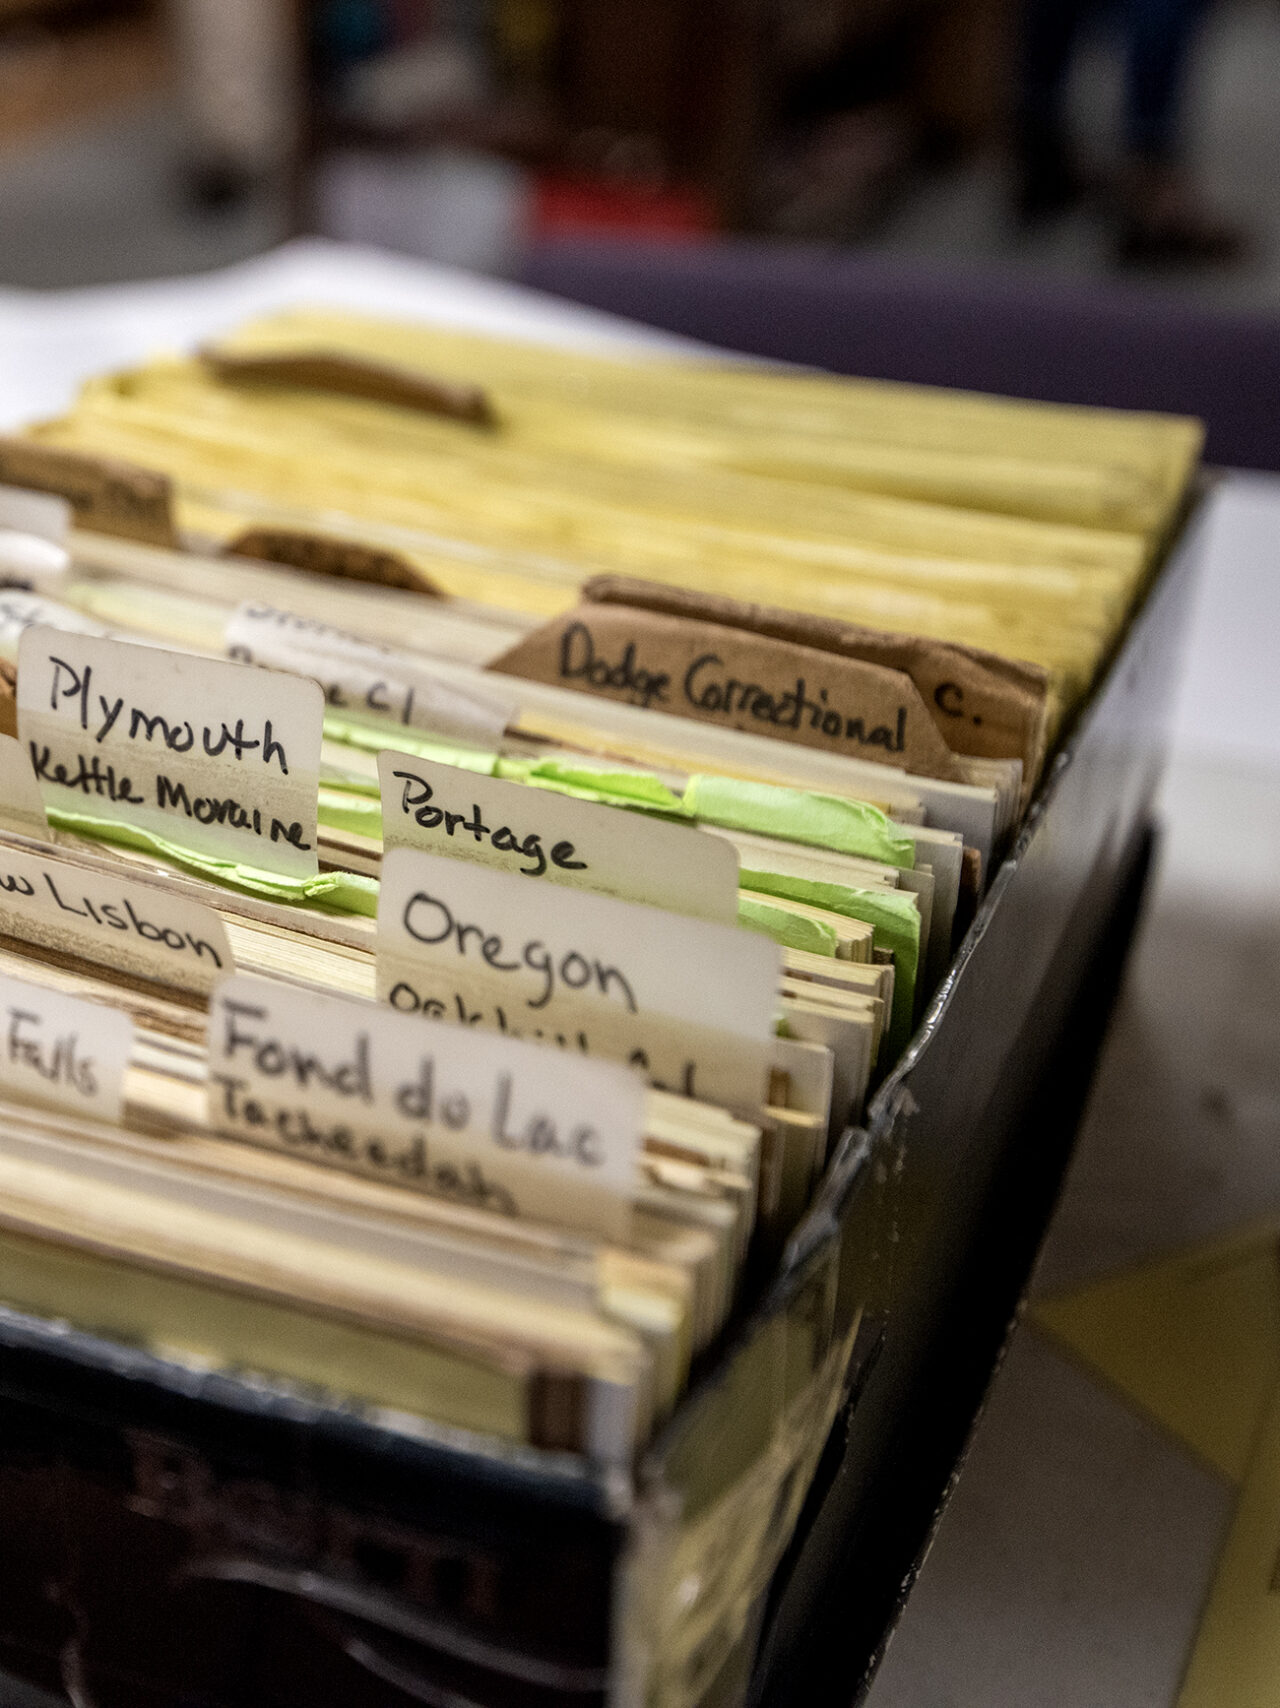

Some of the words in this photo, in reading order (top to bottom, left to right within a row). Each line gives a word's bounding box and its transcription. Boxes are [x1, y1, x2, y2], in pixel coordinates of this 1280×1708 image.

[48, 655, 289, 776] Plymouth
[560, 621, 670, 708] Dodge
[684, 653, 908, 753] Correctional
[28, 740, 146, 806] Kettle
[156, 774, 313, 852] Moraine
[393, 770, 588, 876] Portage
[42, 872, 223, 969] Lisbon
[402, 891, 638, 1014] Oregon
[5, 1005, 99, 1098] Falls
[221, 998, 374, 1105] Fond
[491, 1066, 606, 1168] Lac
